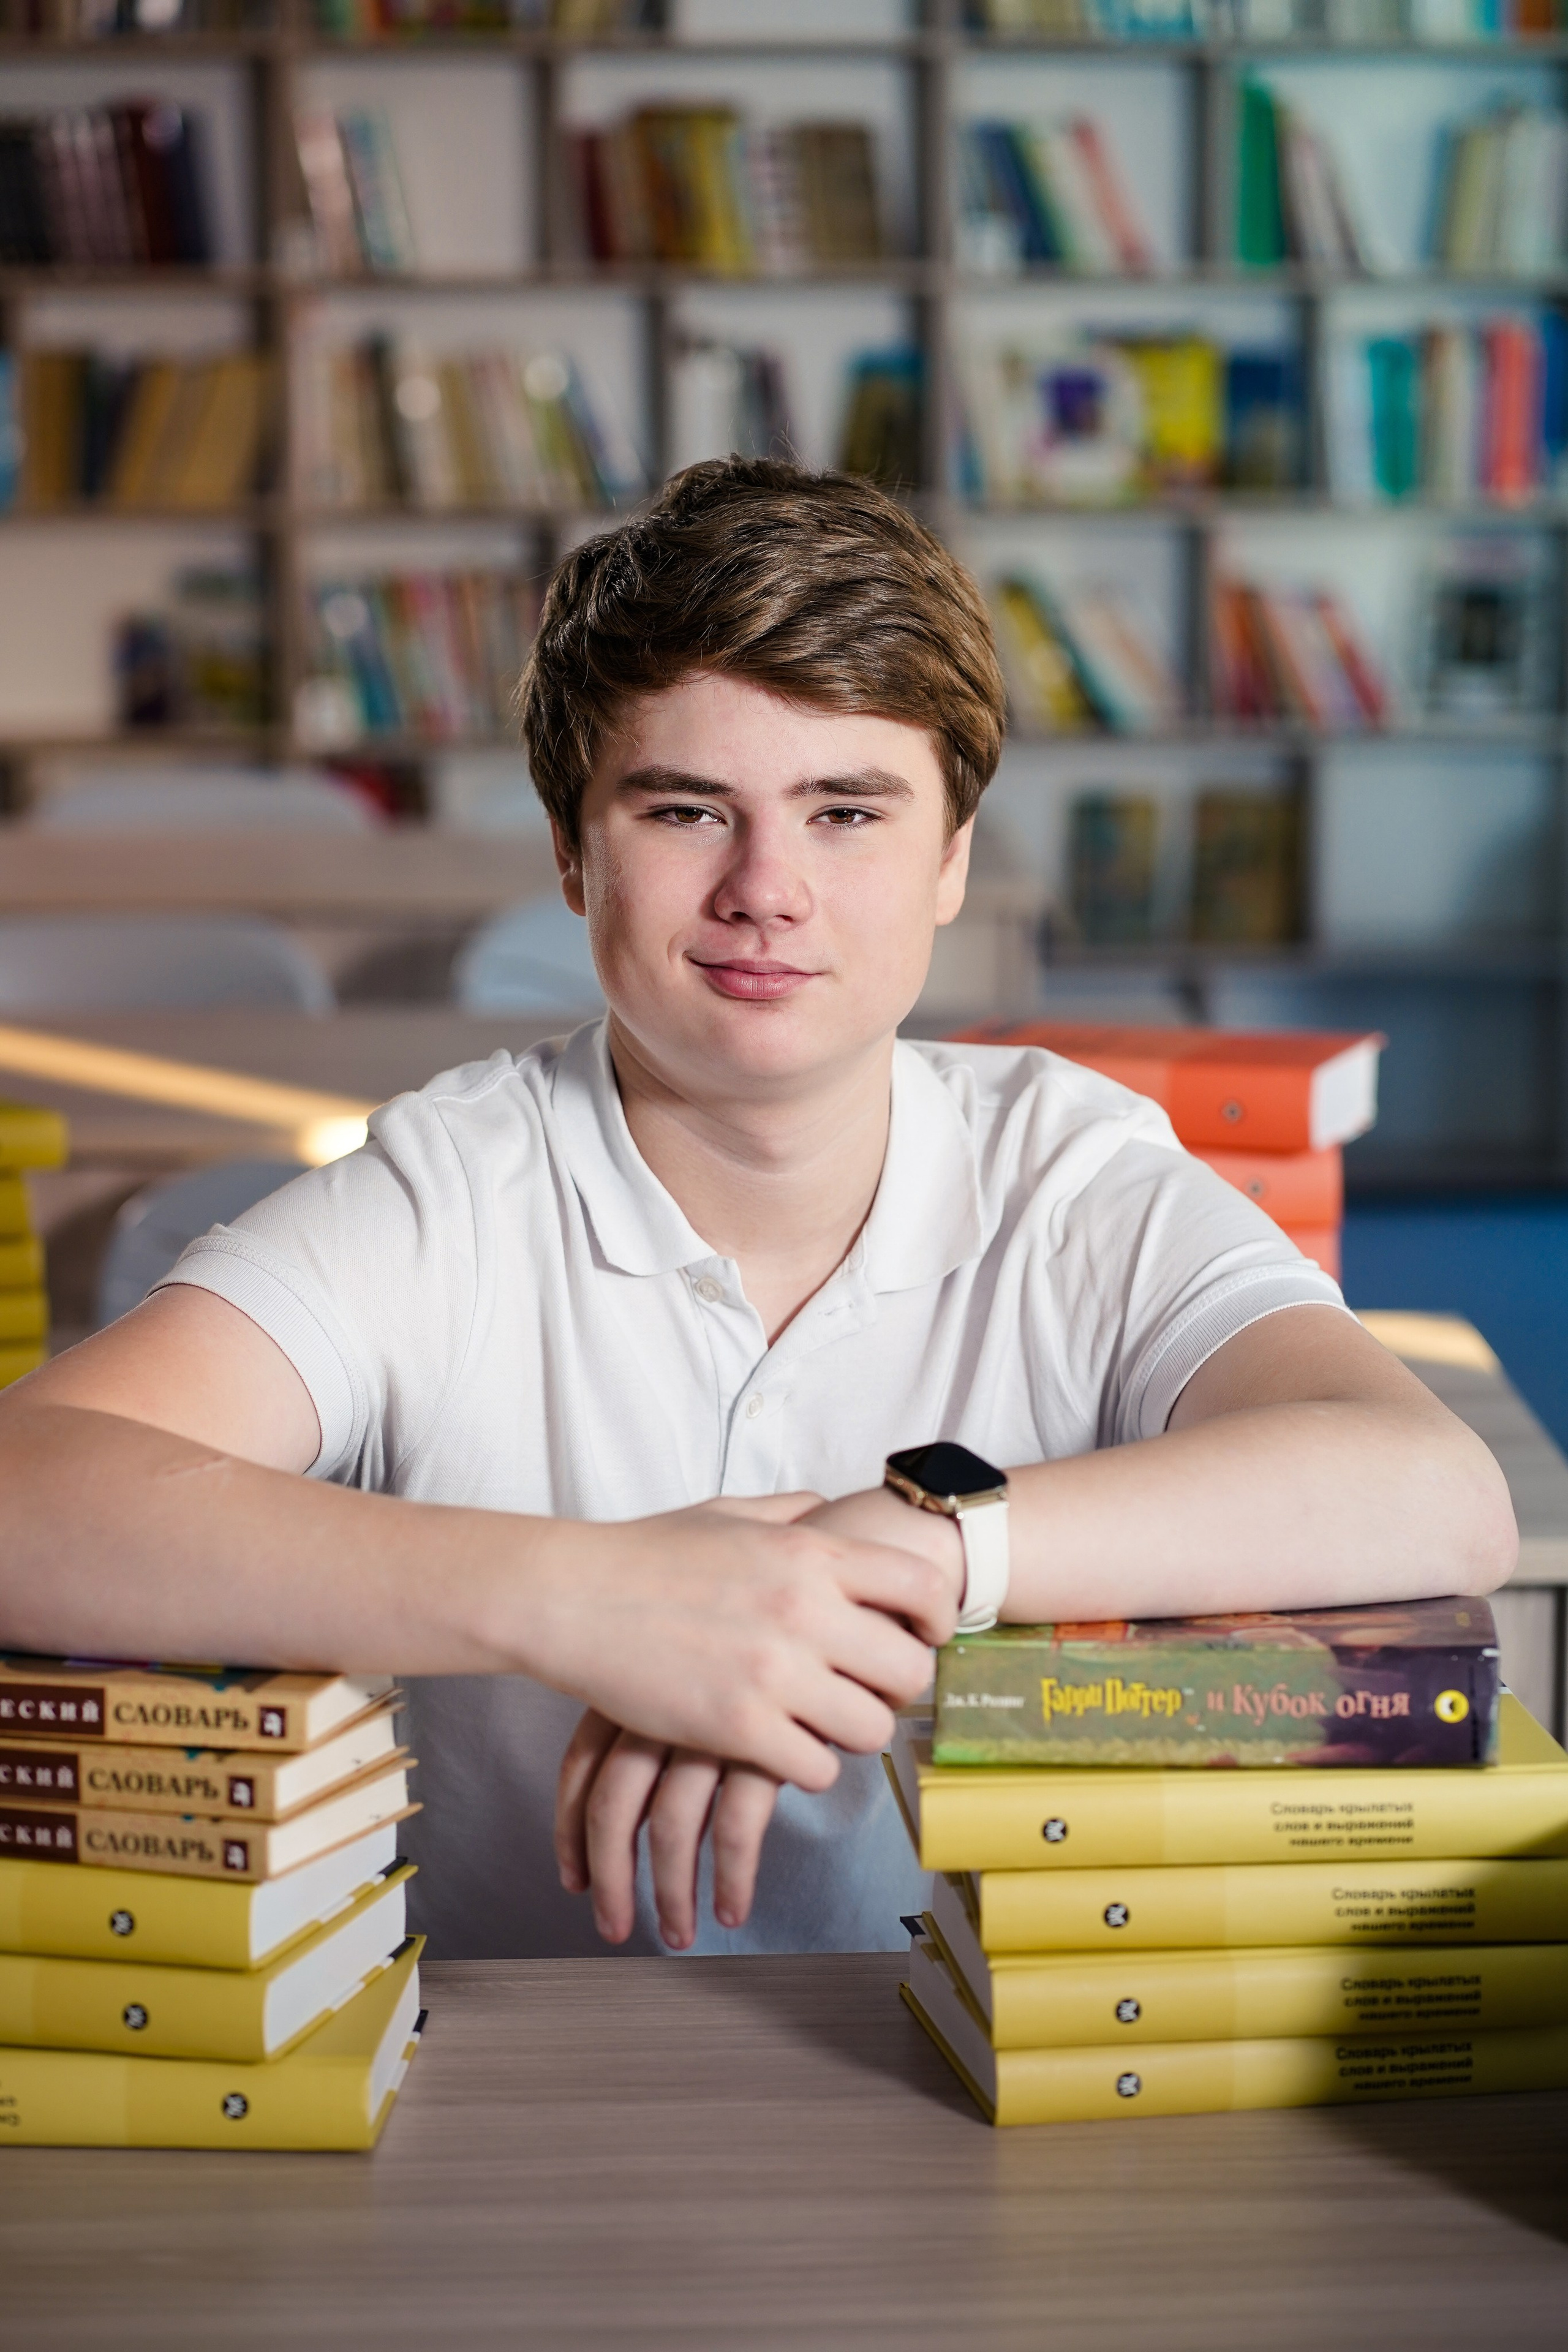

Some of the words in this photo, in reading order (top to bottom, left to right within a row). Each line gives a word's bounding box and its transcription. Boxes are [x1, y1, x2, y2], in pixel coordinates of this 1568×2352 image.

[1041, 1677, 1102, 1725] Гарри
[1105, 1678, 1182, 1717] Поттер
[1206, 1690, 1225, 1712] и
[1232, 1683, 1327, 1726] Кубок
[1335, 1689, 1411, 1719] огня
[114, 1702, 249, 1730] СЛОВАРЬ
[88, 1767, 219, 1800] СЛОВАРЬ
[1271, 1801, 1334, 1815] Словарь
[1339, 1802, 1413, 1814] крылатых
[86, 1828, 213, 1862] СЛОВАРЬ
[1332, 1887, 1396, 1900] Словарь
[1400, 1888, 1475, 1900] крылатых
[1341, 1978, 1404, 1991] Словарь
[1336, 2046, 1398, 2061] Словарь
